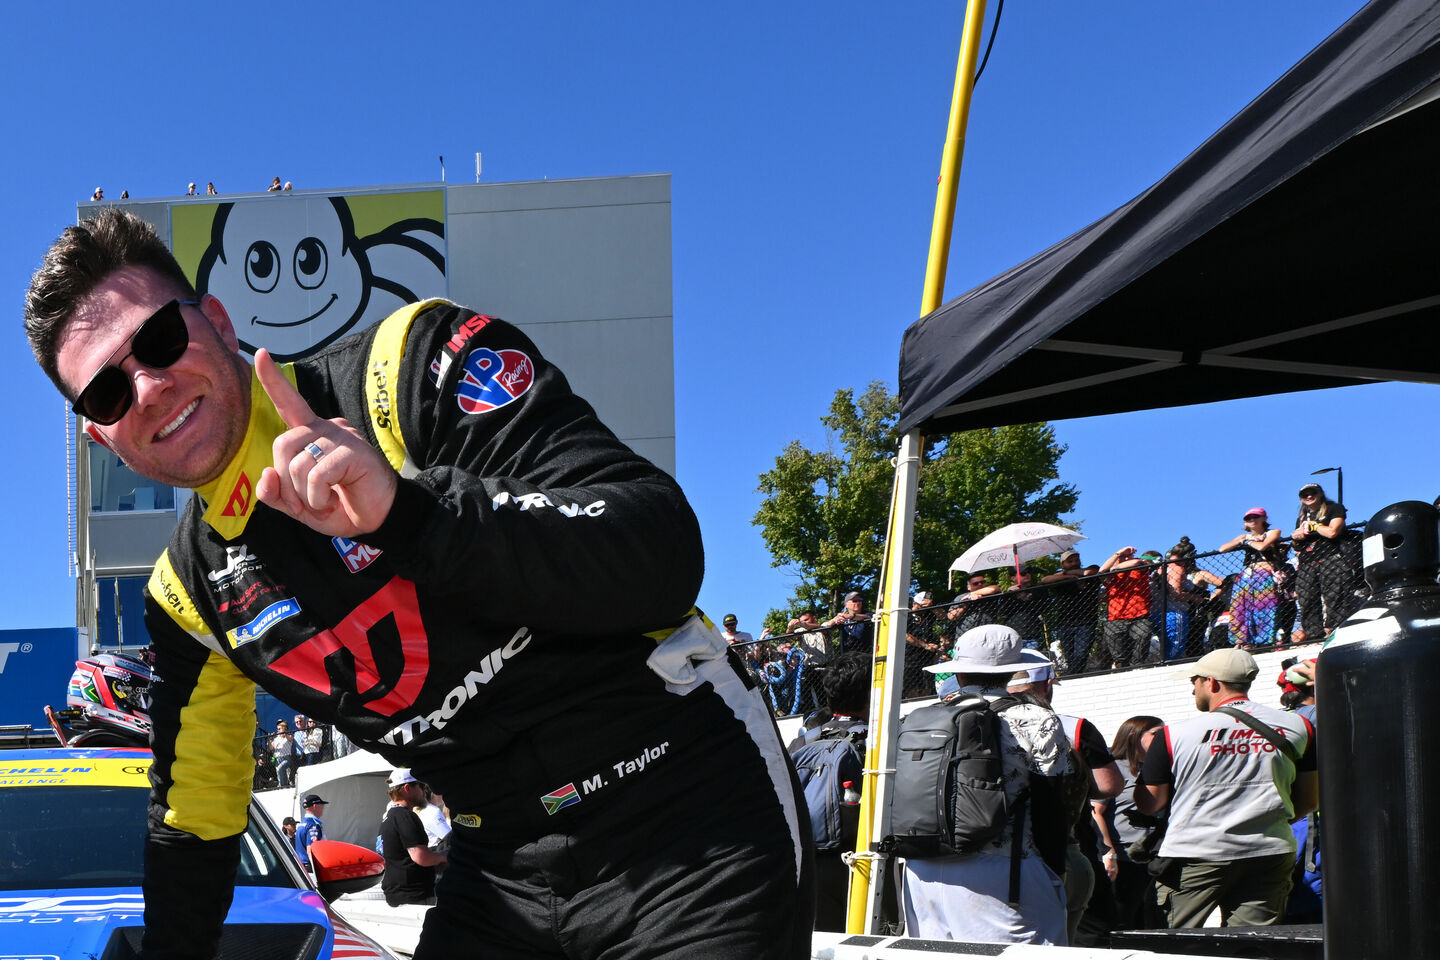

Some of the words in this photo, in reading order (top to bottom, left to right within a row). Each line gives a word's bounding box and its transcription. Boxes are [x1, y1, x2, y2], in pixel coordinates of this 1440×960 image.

[373, 360, 392, 429] Sabelt
[501, 356, 530, 391] Racing
[252, 603, 291, 635] MICHELIN
[378, 626, 532, 746] ITRONIC
[582, 774, 609, 795] M.
[613, 741, 669, 779] Taylor
[1211, 742, 1276, 756] PHOTO
